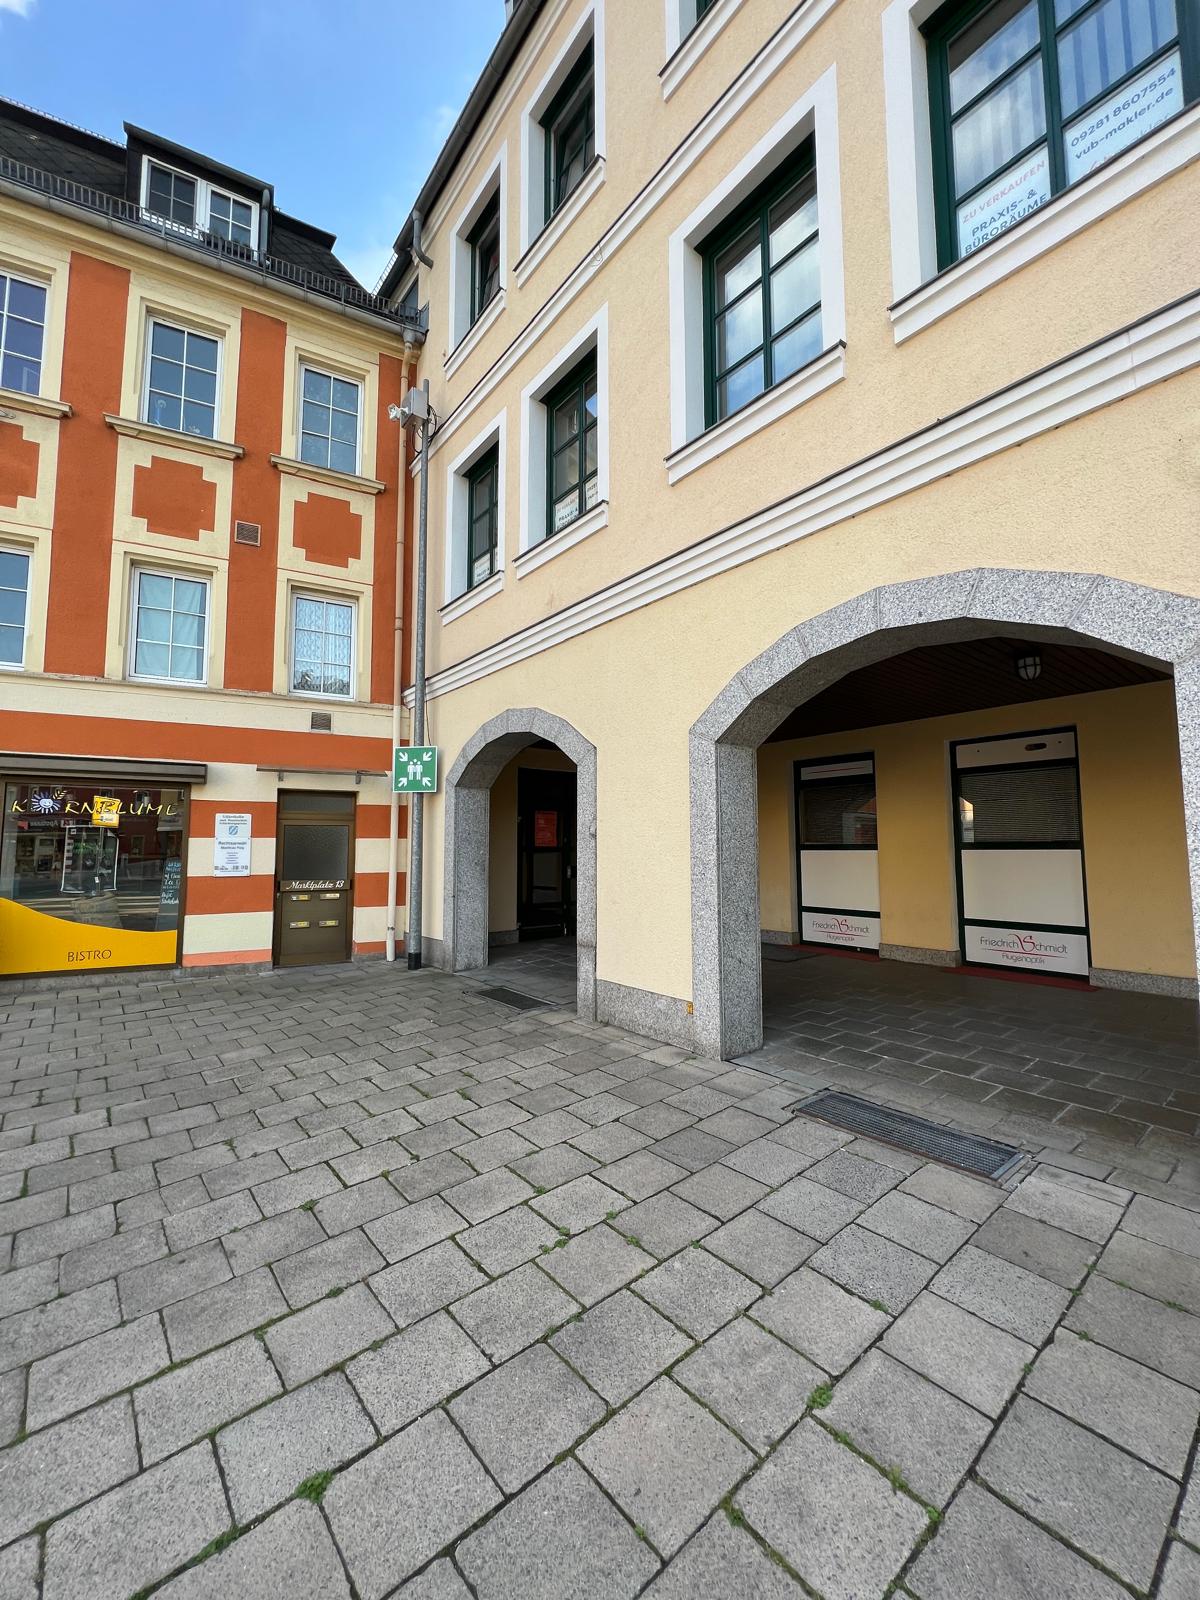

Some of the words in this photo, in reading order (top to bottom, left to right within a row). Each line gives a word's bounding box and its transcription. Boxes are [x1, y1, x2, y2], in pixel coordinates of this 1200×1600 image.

[1070, 115, 1110, 148] 09281
[1112, 66, 1177, 117] 8607554
[1075, 86, 1174, 160] vub-makler.de
[962, 208, 977, 225] ZU
[978, 159, 1046, 213] VERKAUFEN
[964, 193, 1048, 254] BÜRORÄUME
[971, 198, 1023, 237] PRAXIS-
[1026, 187, 1038, 201] &
[286, 881, 334, 892] Marktplatz
[335, 880, 345, 888] 13
[812, 919, 839, 931] Friedrich
[838, 919, 870, 934] Schmidt
[67, 949, 113, 963] BISTRO
[979, 935, 1020, 950] Friedrich
[1017, 934, 1068, 955] Schmidt
[1001, 953, 1047, 965] Augenoptik
